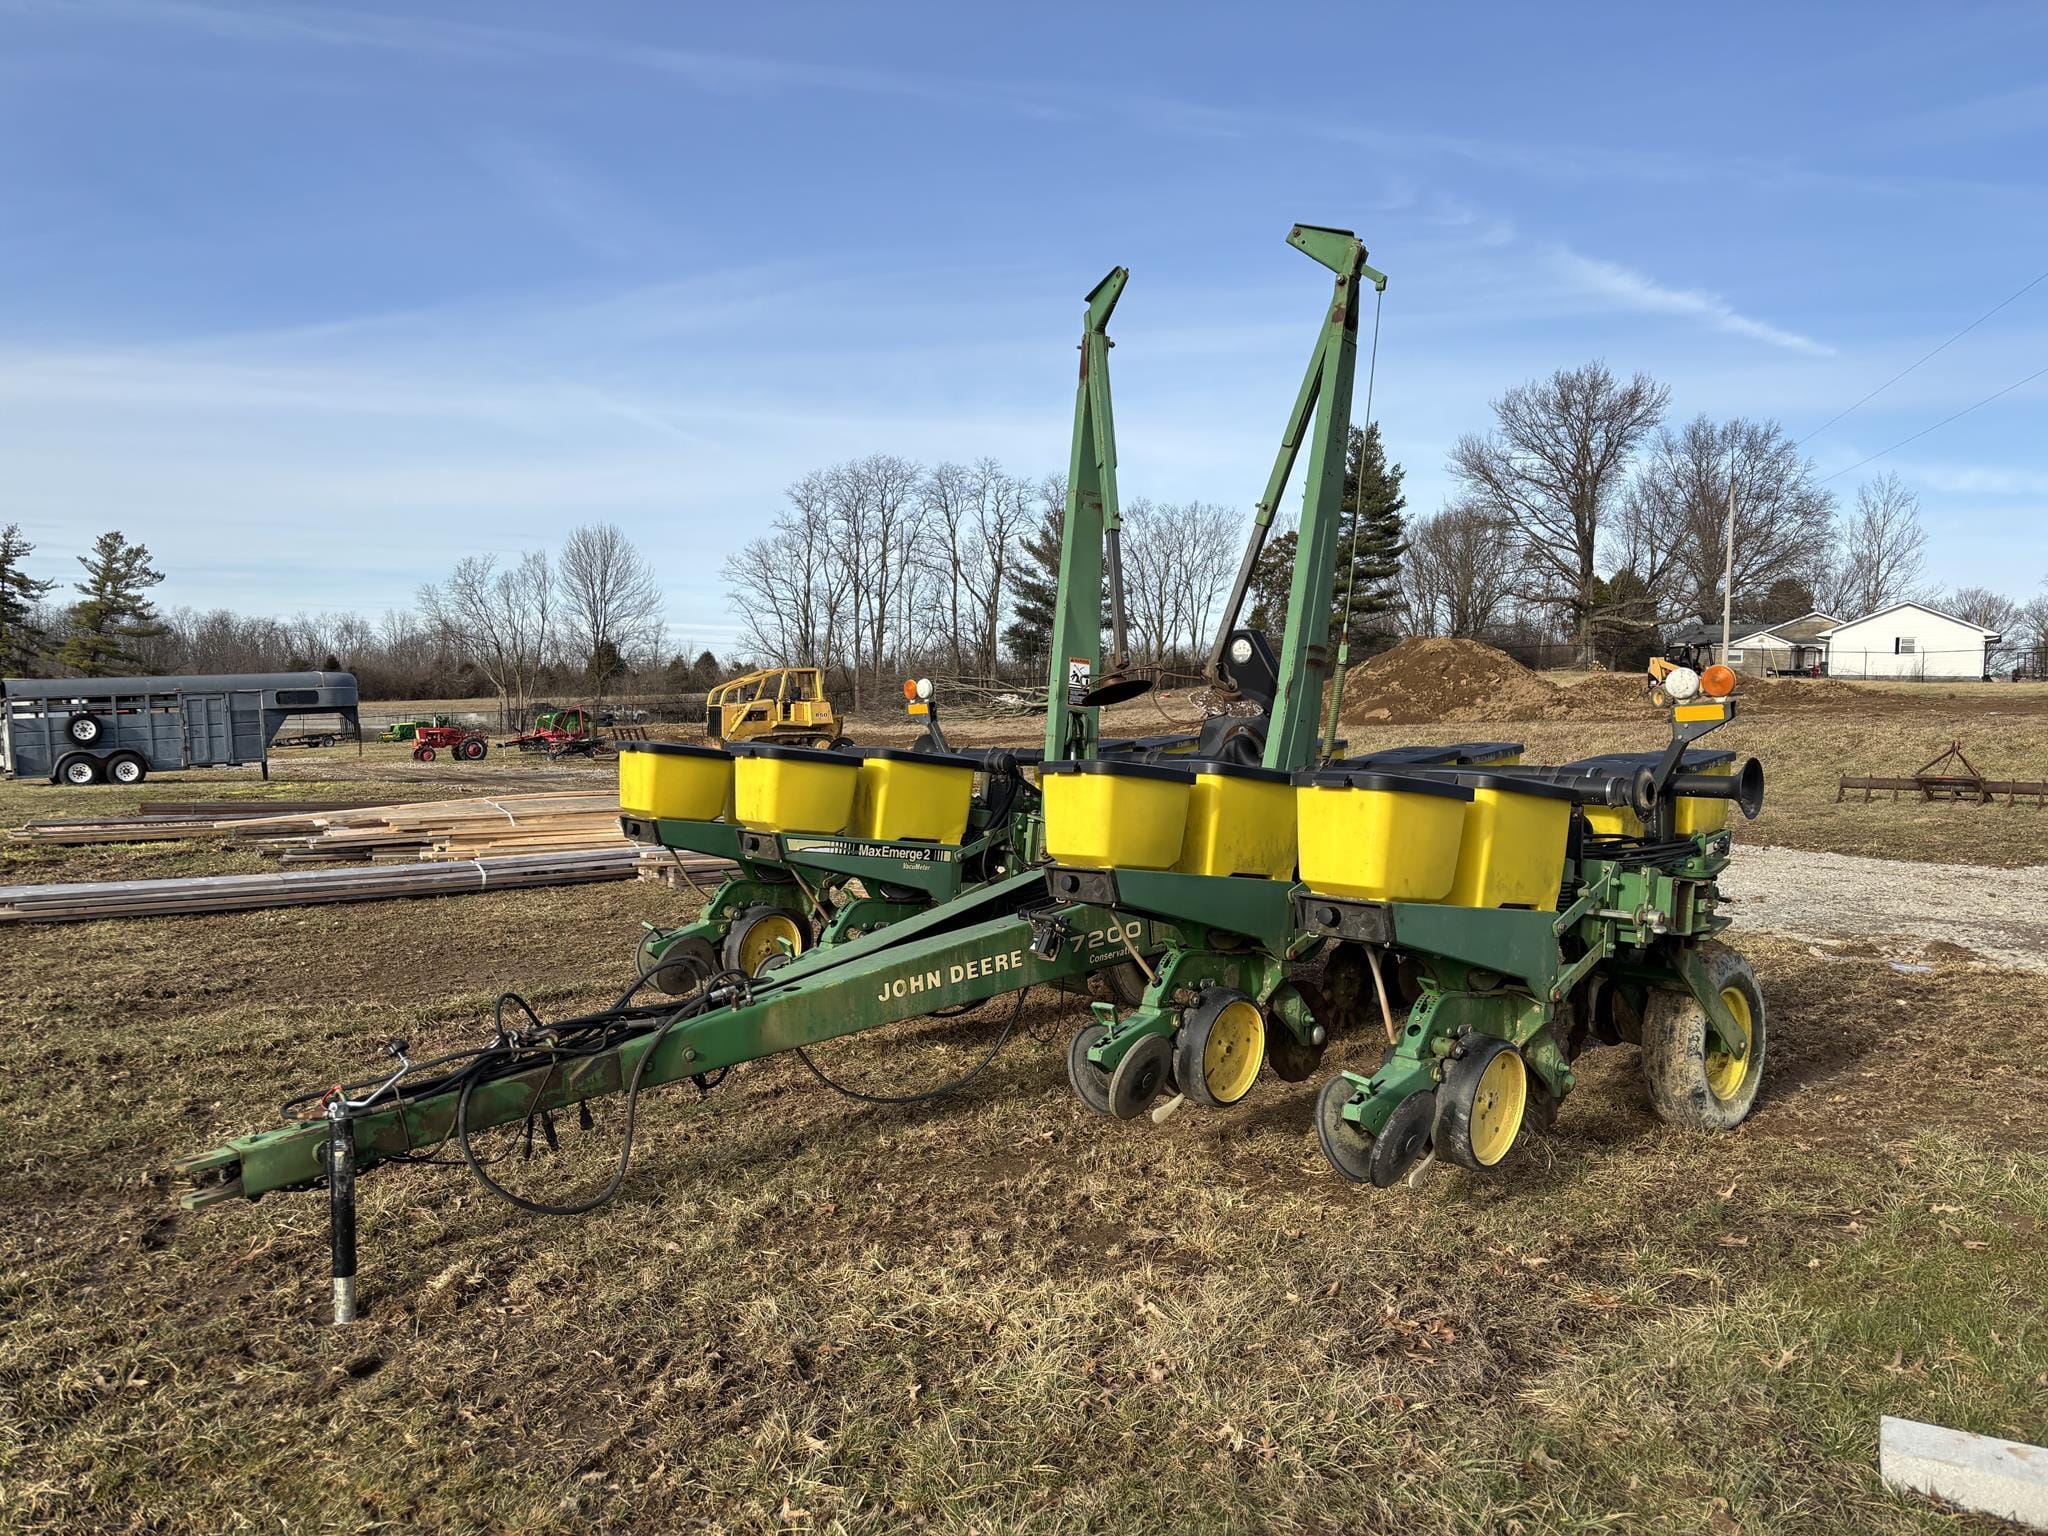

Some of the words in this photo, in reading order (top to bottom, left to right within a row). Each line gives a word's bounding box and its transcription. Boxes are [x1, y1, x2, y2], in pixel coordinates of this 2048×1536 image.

[1070, 921, 1141, 953] 7200
[878, 970, 942, 1002] JOHN
[950, 950, 1023, 984] DEERE
